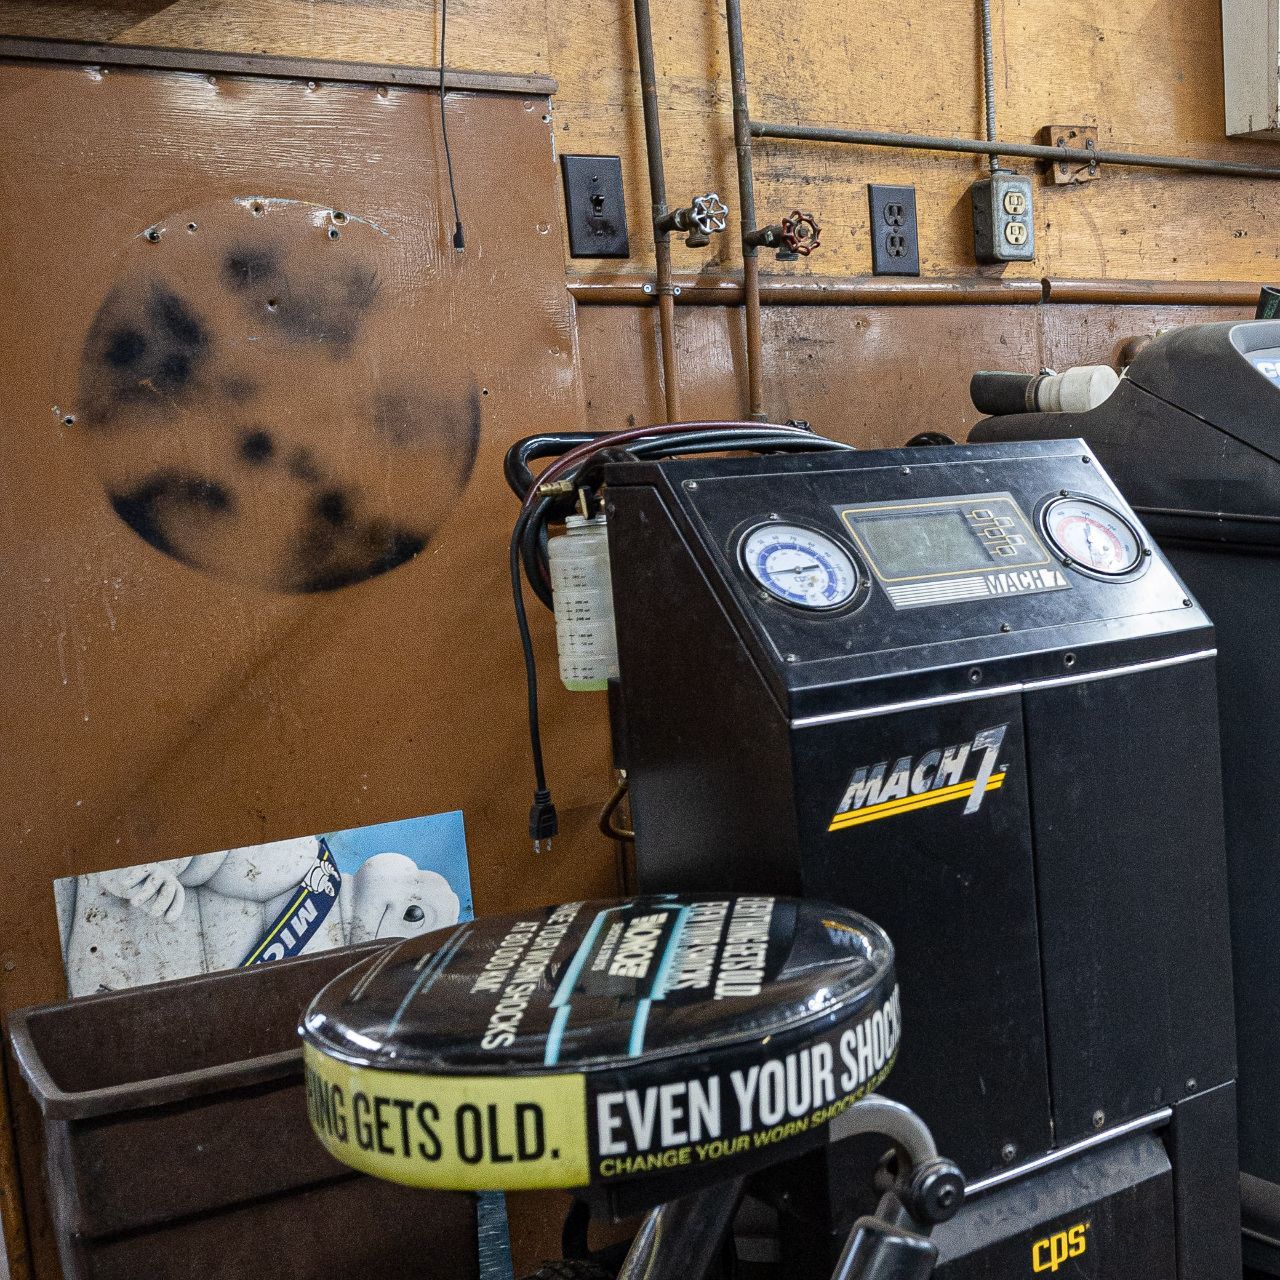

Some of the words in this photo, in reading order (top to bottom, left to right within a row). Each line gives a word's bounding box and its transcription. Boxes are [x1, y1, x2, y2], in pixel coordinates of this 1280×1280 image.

[719, 942, 769, 970] GETS
[480, 982, 538, 1050] SHOCKS
[352, 1091, 443, 1163] GETS
[455, 1102, 560, 1165] OLD.
[597, 1075, 721, 1157] EVEN
[730, 1041, 837, 1133] YOUR
[599, 1146, 692, 1178] CHANGE
[695, 1135, 750, 1162] YOUR
[752, 1119, 808, 1148] WORN
